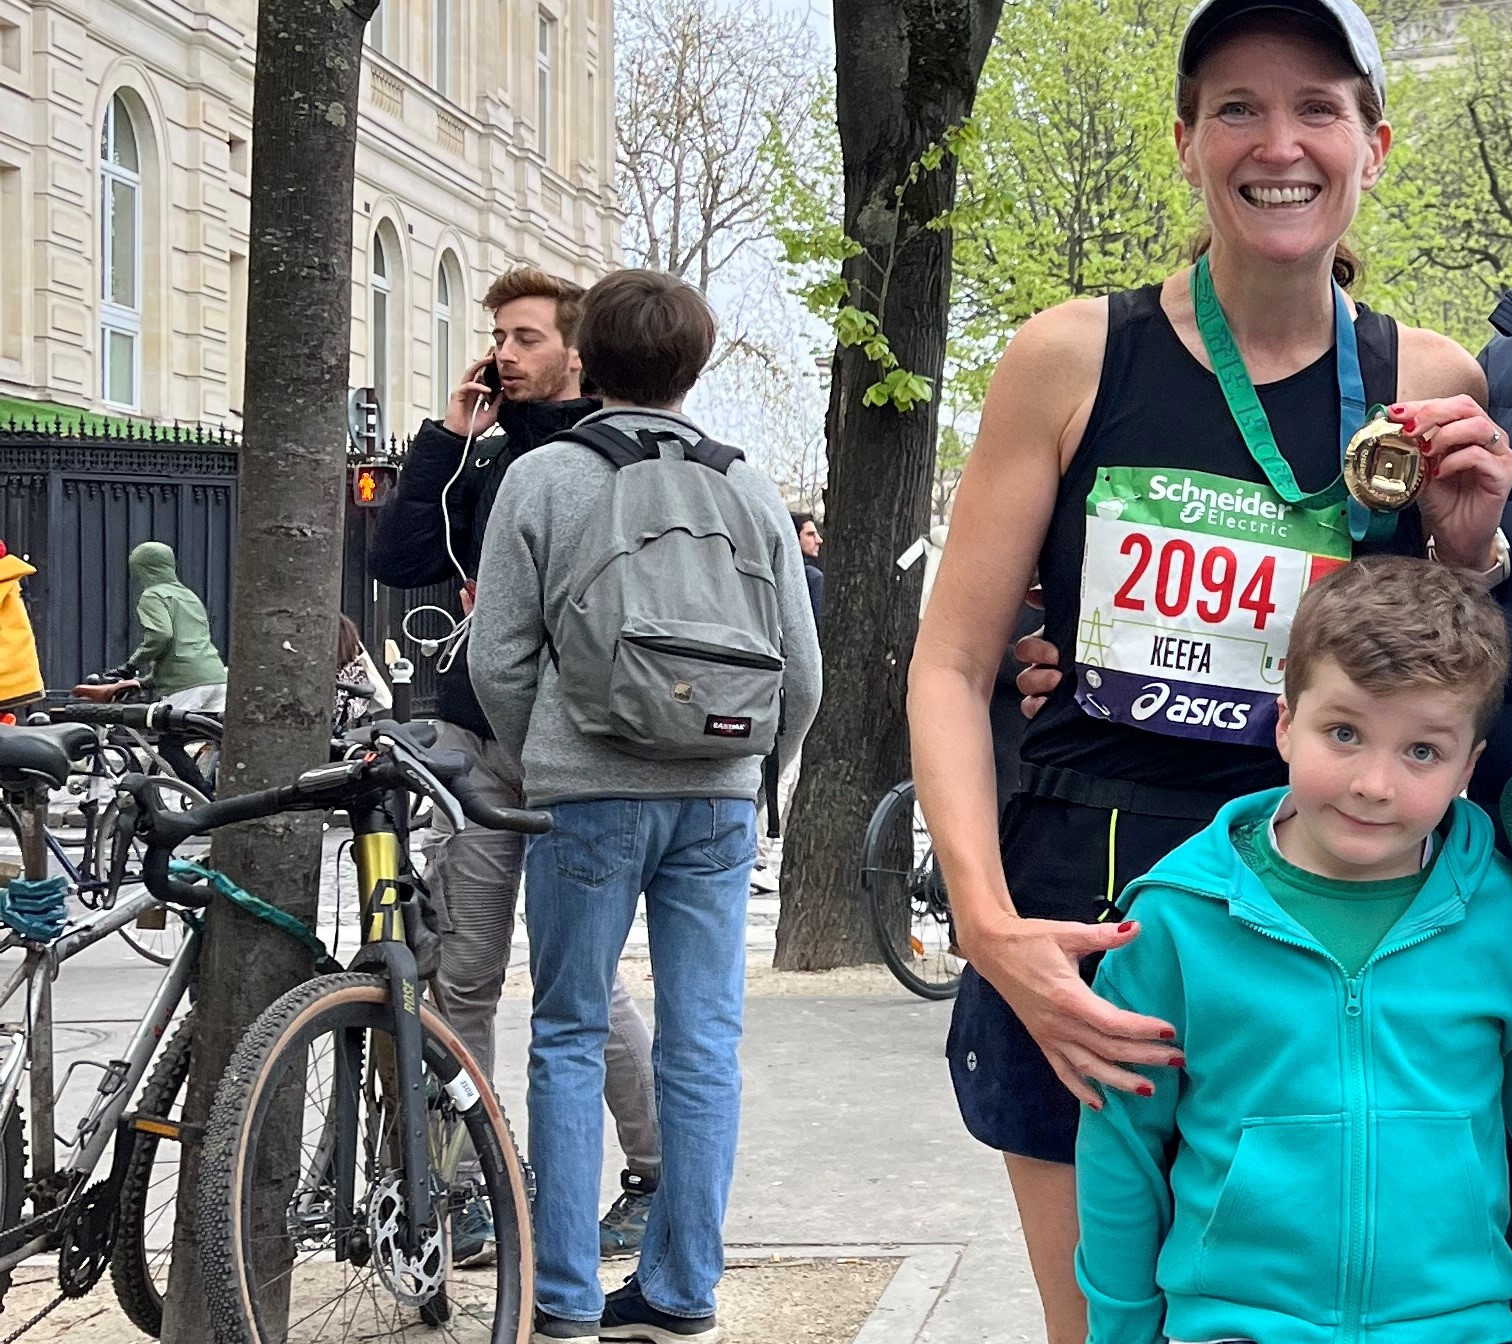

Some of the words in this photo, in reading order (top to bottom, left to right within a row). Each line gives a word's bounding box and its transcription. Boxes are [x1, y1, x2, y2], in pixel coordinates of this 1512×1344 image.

[1149, 474, 1293, 522] Schneider
[1206, 508, 1288, 539] Electric
[1113, 532, 1277, 631] 2094
[1150, 635, 1212, 674] KEEFA
[402, 978, 416, 1016] ROSE
